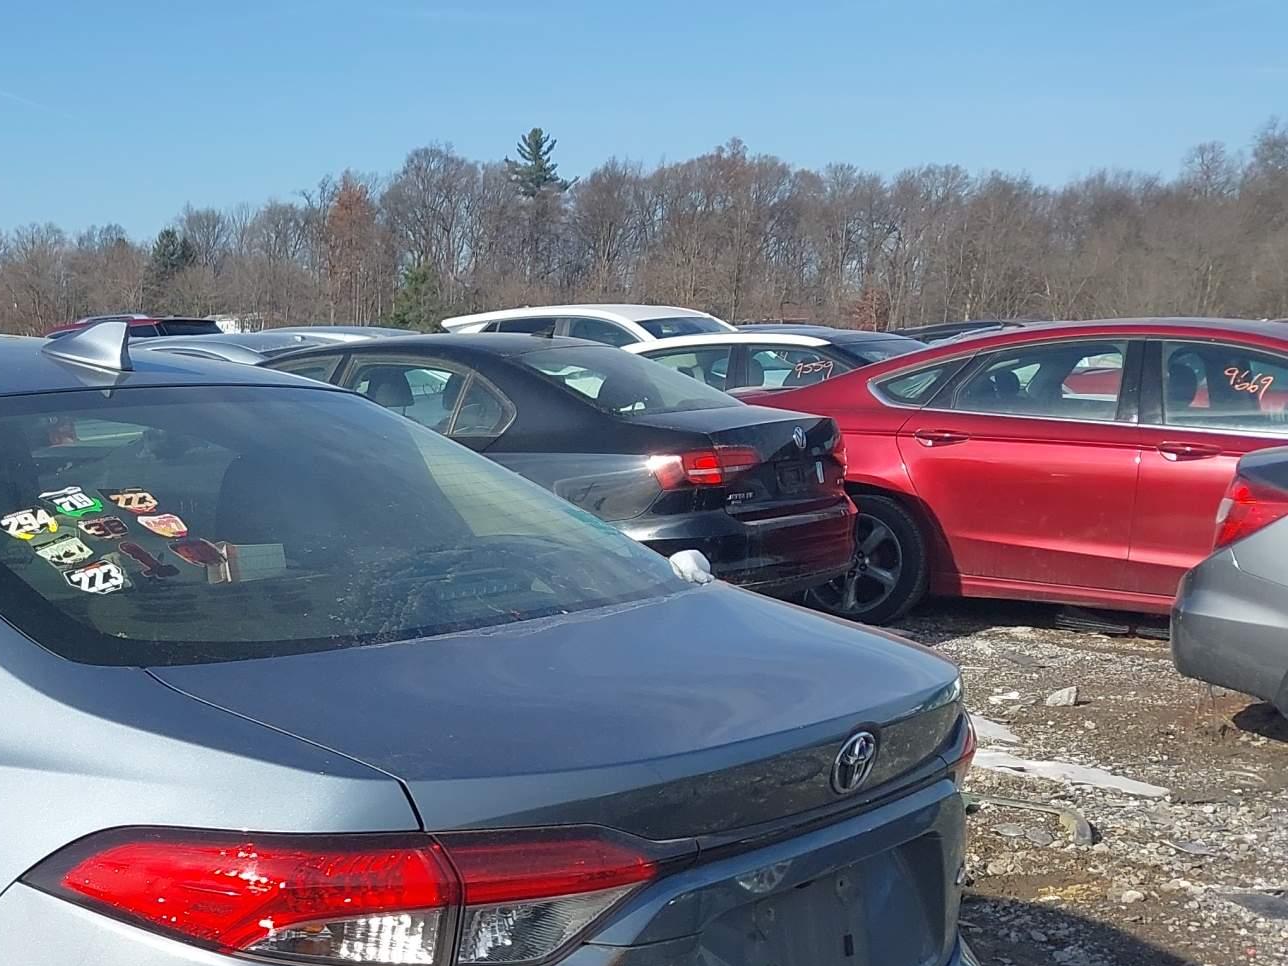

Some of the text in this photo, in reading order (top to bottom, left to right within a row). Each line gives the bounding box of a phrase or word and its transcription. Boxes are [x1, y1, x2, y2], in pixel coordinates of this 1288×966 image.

[53, 492, 96, 511] 719
[109, 492, 159, 510] 223
[0, 508, 59, 540] 294
[70, 564, 124, 593] 223
